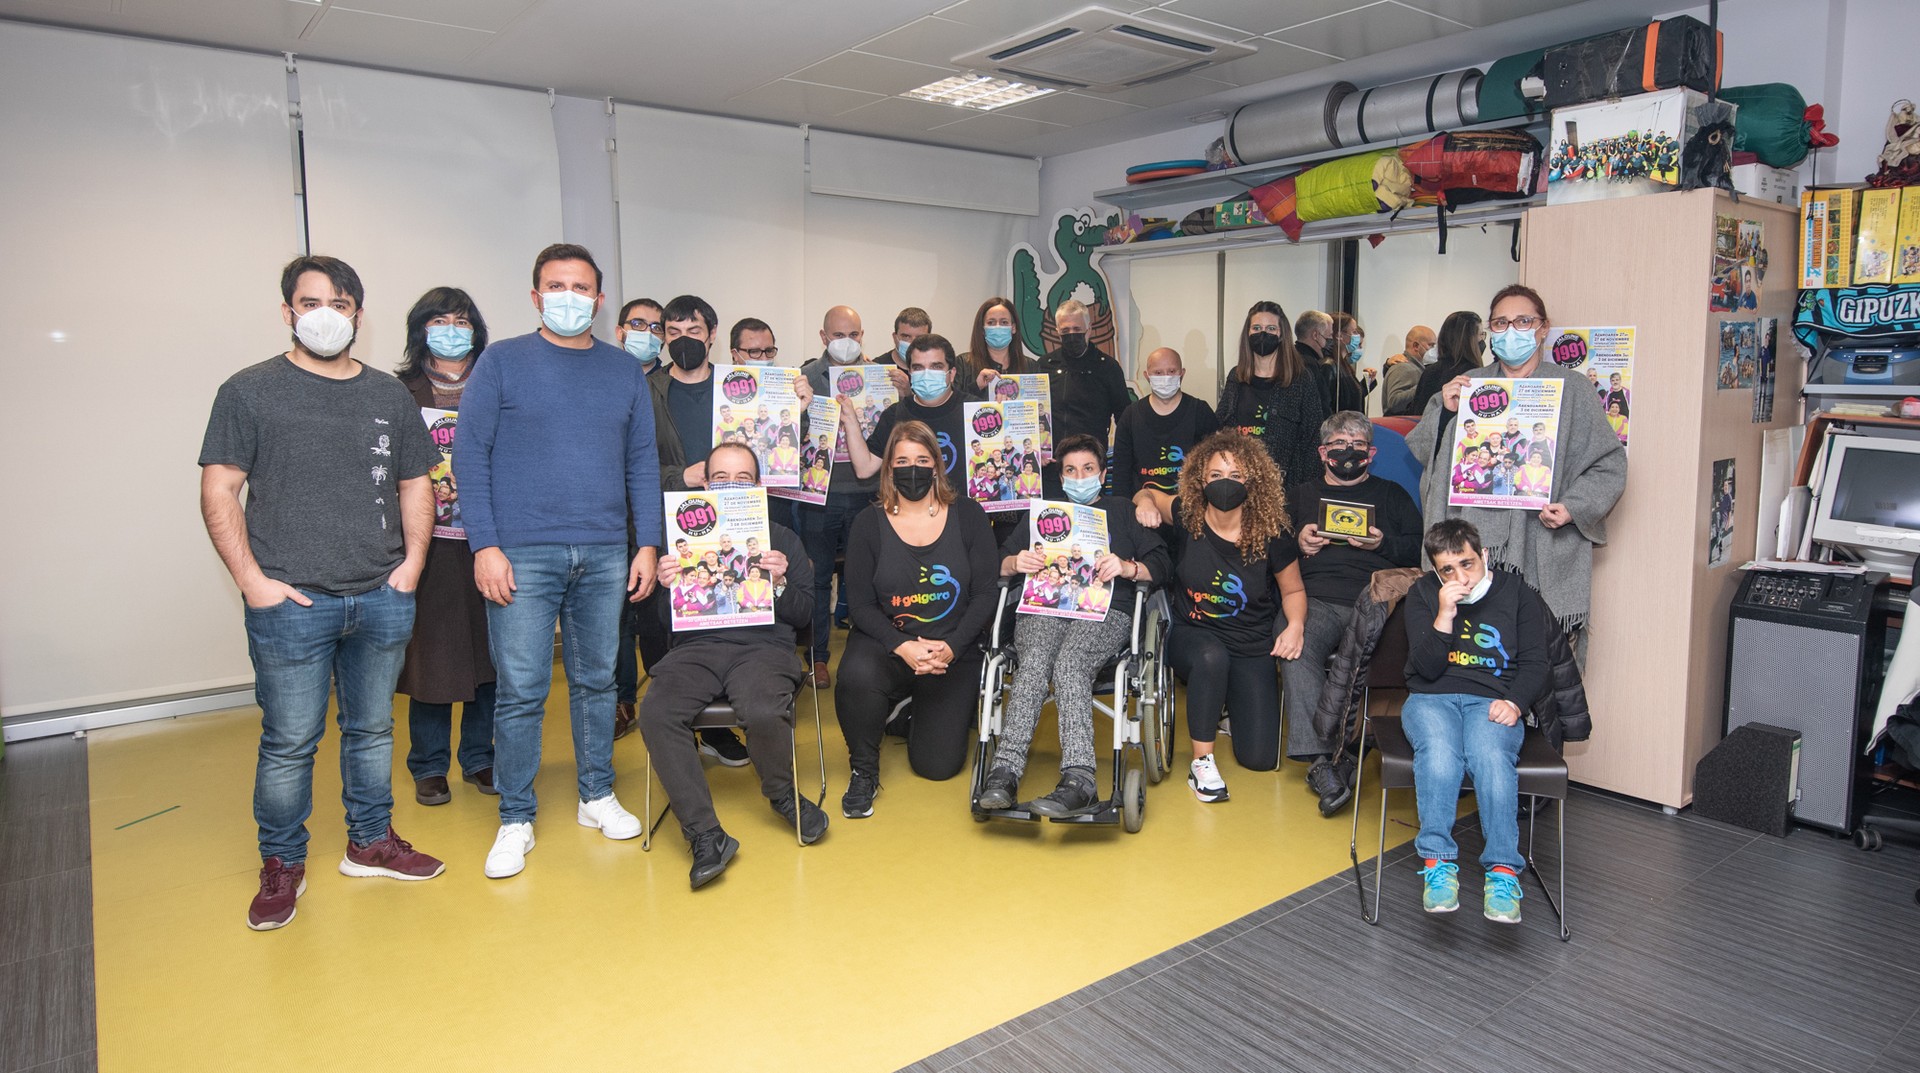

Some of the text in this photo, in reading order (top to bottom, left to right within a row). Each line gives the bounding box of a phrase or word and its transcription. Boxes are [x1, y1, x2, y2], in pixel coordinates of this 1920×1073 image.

[1840, 292, 1920, 323] GIPUZK
[1554, 341, 1586, 362] 1991
[724, 378, 756, 397] 1991
[837, 376, 864, 392] 1991
[1470, 391, 1507, 411] 1991
[973, 413, 1002, 432] 1991
[677, 505, 716, 529] 1991
[1038, 516, 1070, 535] 1991
[891, 591, 950, 607] #gaigara
[1448, 651, 1496, 668] aigara
